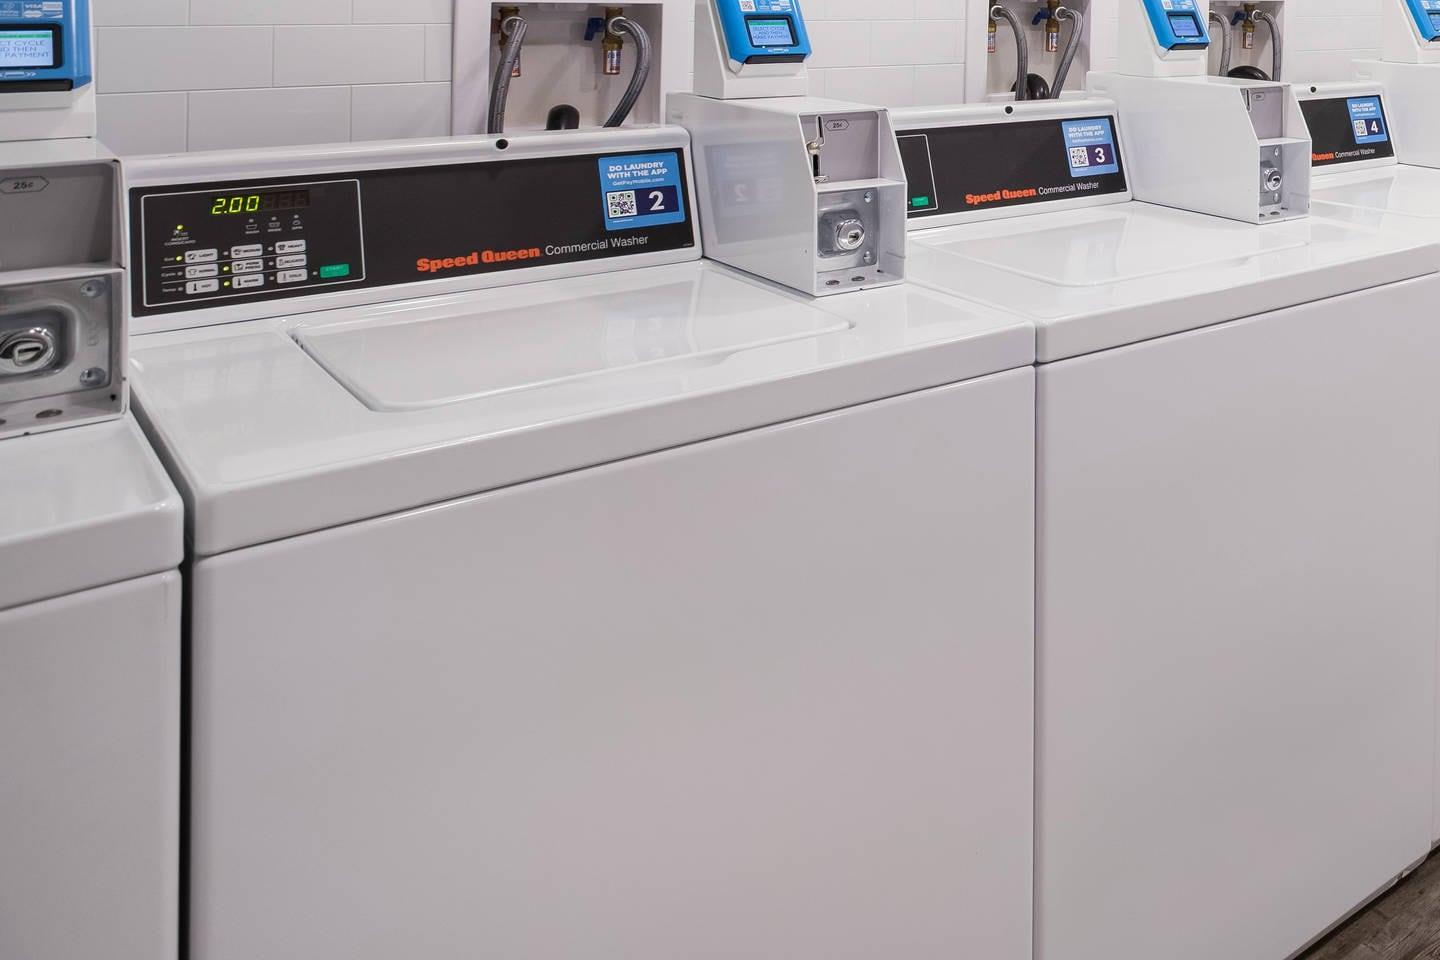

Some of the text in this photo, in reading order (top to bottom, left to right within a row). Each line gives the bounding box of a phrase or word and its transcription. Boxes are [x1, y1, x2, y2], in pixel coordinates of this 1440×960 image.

[1370, 120, 1379, 133] 4
[1094, 147, 1106, 163] 3
[607, 171, 631, 179] WITH
[651, 168, 668, 176] APP
[624, 161, 664, 171] LAUNDRY
[648, 190, 665, 211] 2
[965, 181, 1100, 205] Speed Queen Commercial Washer
[211, 195, 260, 215] 2.00
[416, 235, 649, 273] Speed Queen Commercial Washer
